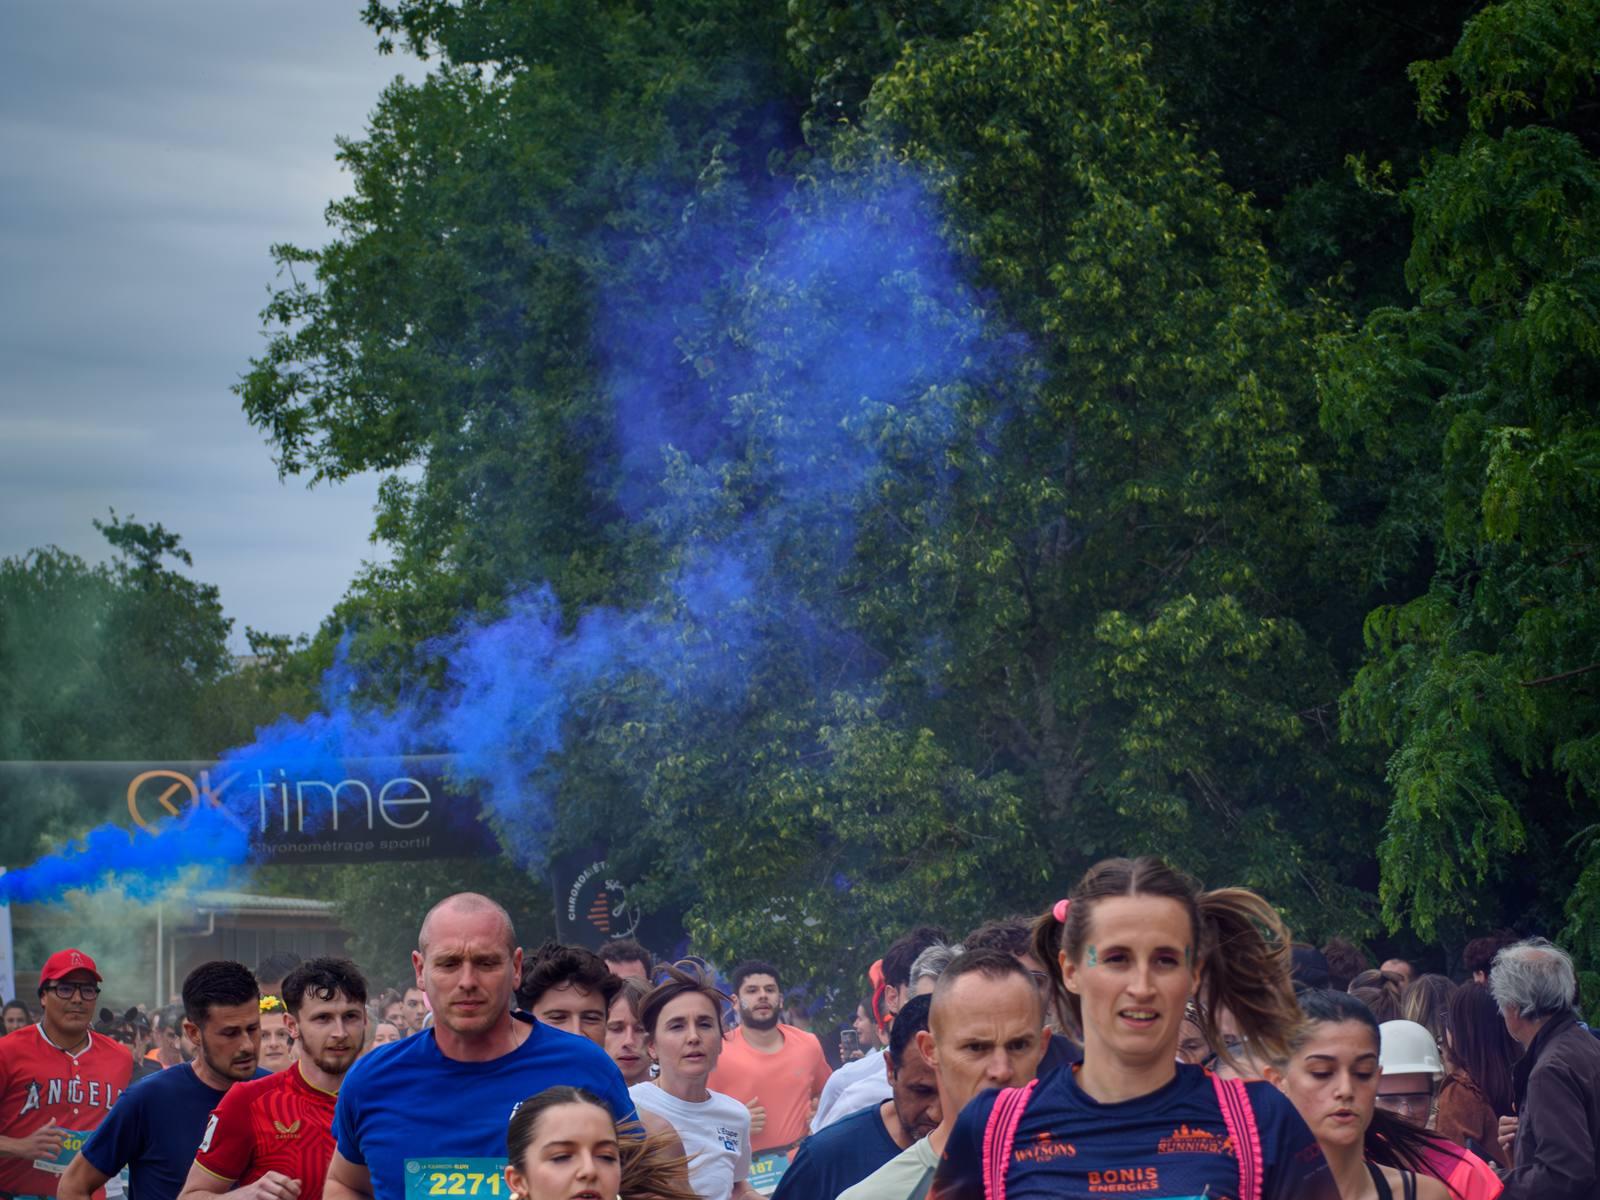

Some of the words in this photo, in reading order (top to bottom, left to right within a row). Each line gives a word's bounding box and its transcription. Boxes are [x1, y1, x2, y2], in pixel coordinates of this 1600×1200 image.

[430, 1173, 499, 1195] 2271
[1088, 1167, 1158, 1184] BONIS
[1089, 1181, 1158, 1192] ENERGIES
